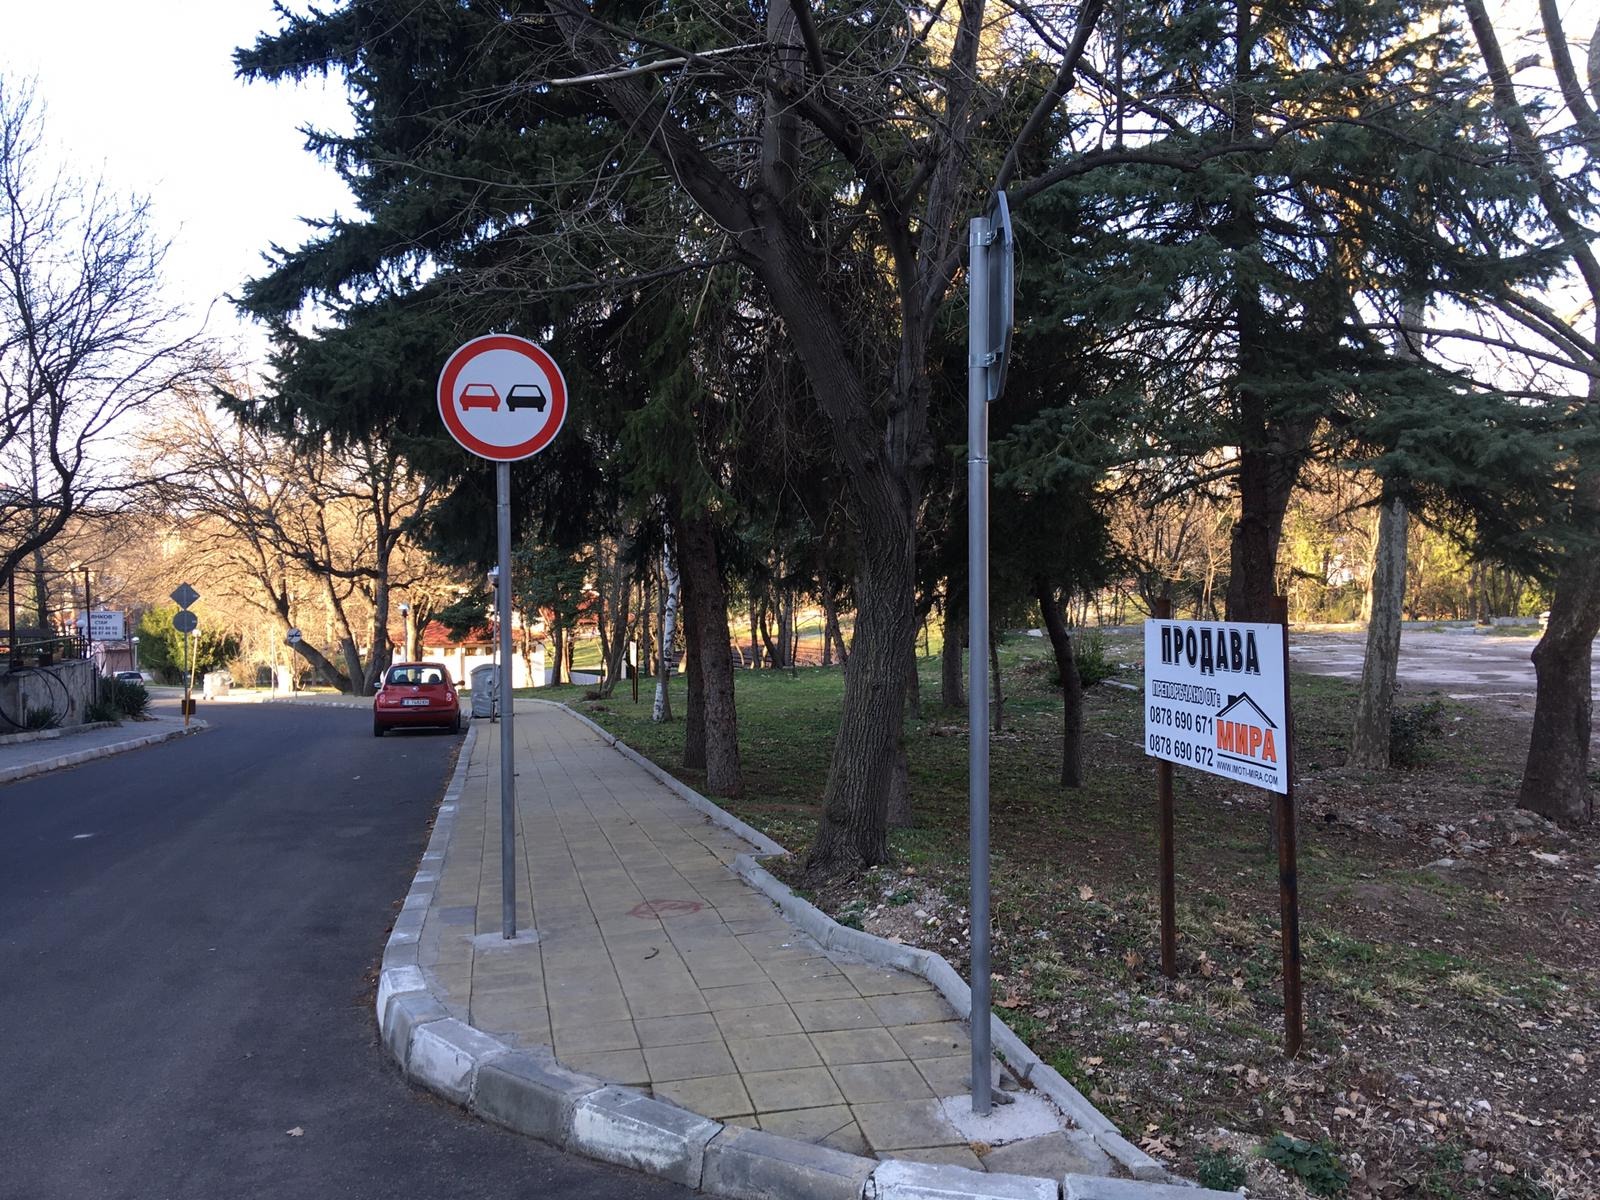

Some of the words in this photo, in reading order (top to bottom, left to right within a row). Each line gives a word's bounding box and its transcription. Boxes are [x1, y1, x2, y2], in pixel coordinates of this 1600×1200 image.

[1161, 624, 1261, 676] ПРОДАВА
[1205, 687, 1221, 708] ОТ:
[1150, 705, 1172, 727] 0878
[1175, 710, 1192, 731] 690
[1195, 714, 1213, 736] 671
[1150, 733, 1171, 756] 0878
[1174, 740, 1192, 761] 690
[1195, 745, 1214, 767] 672
[1216, 719, 1277, 763] МИРА
[1216, 760, 1278, 785] WWW.IMOTI-MIRA.COM
